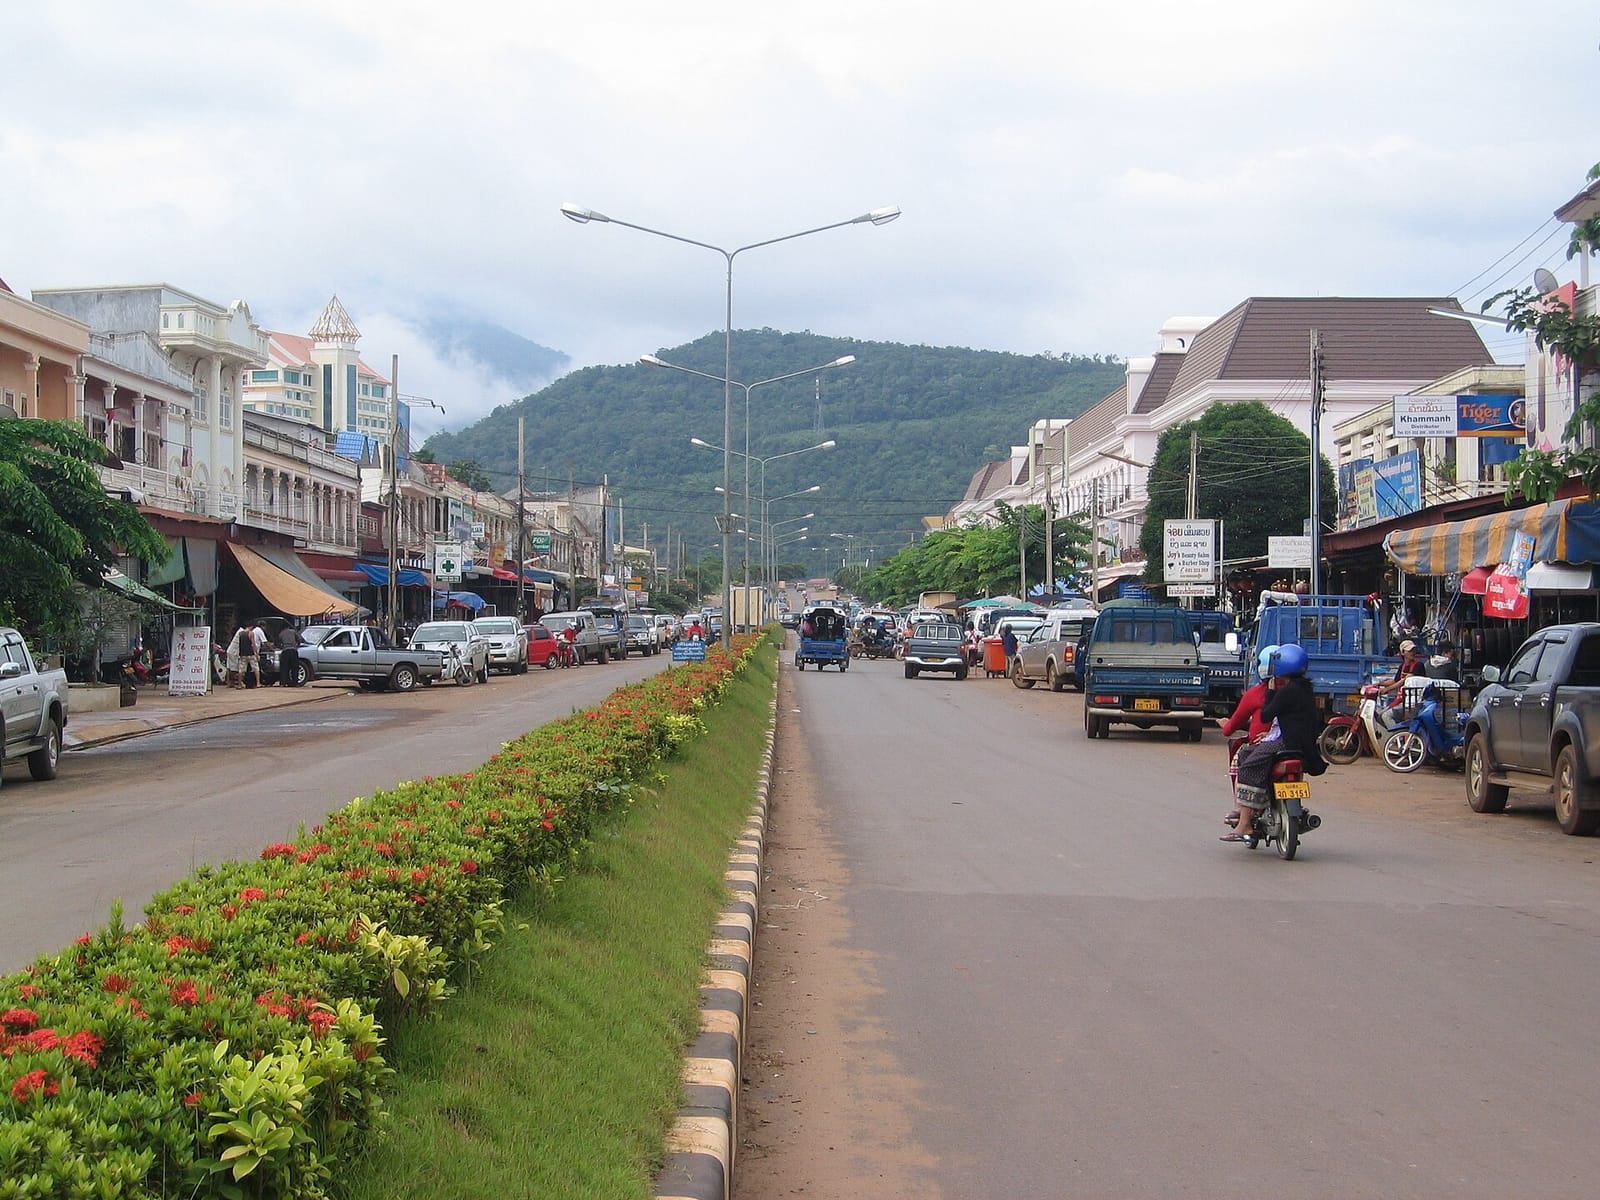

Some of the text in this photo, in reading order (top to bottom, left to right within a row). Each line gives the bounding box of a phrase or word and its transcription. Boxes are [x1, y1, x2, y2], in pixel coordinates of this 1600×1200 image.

[1459, 402, 1502, 424] Tiger
[1400, 415, 1451, 423] Khammanh
[1289, 789, 1308, 798] 3151
